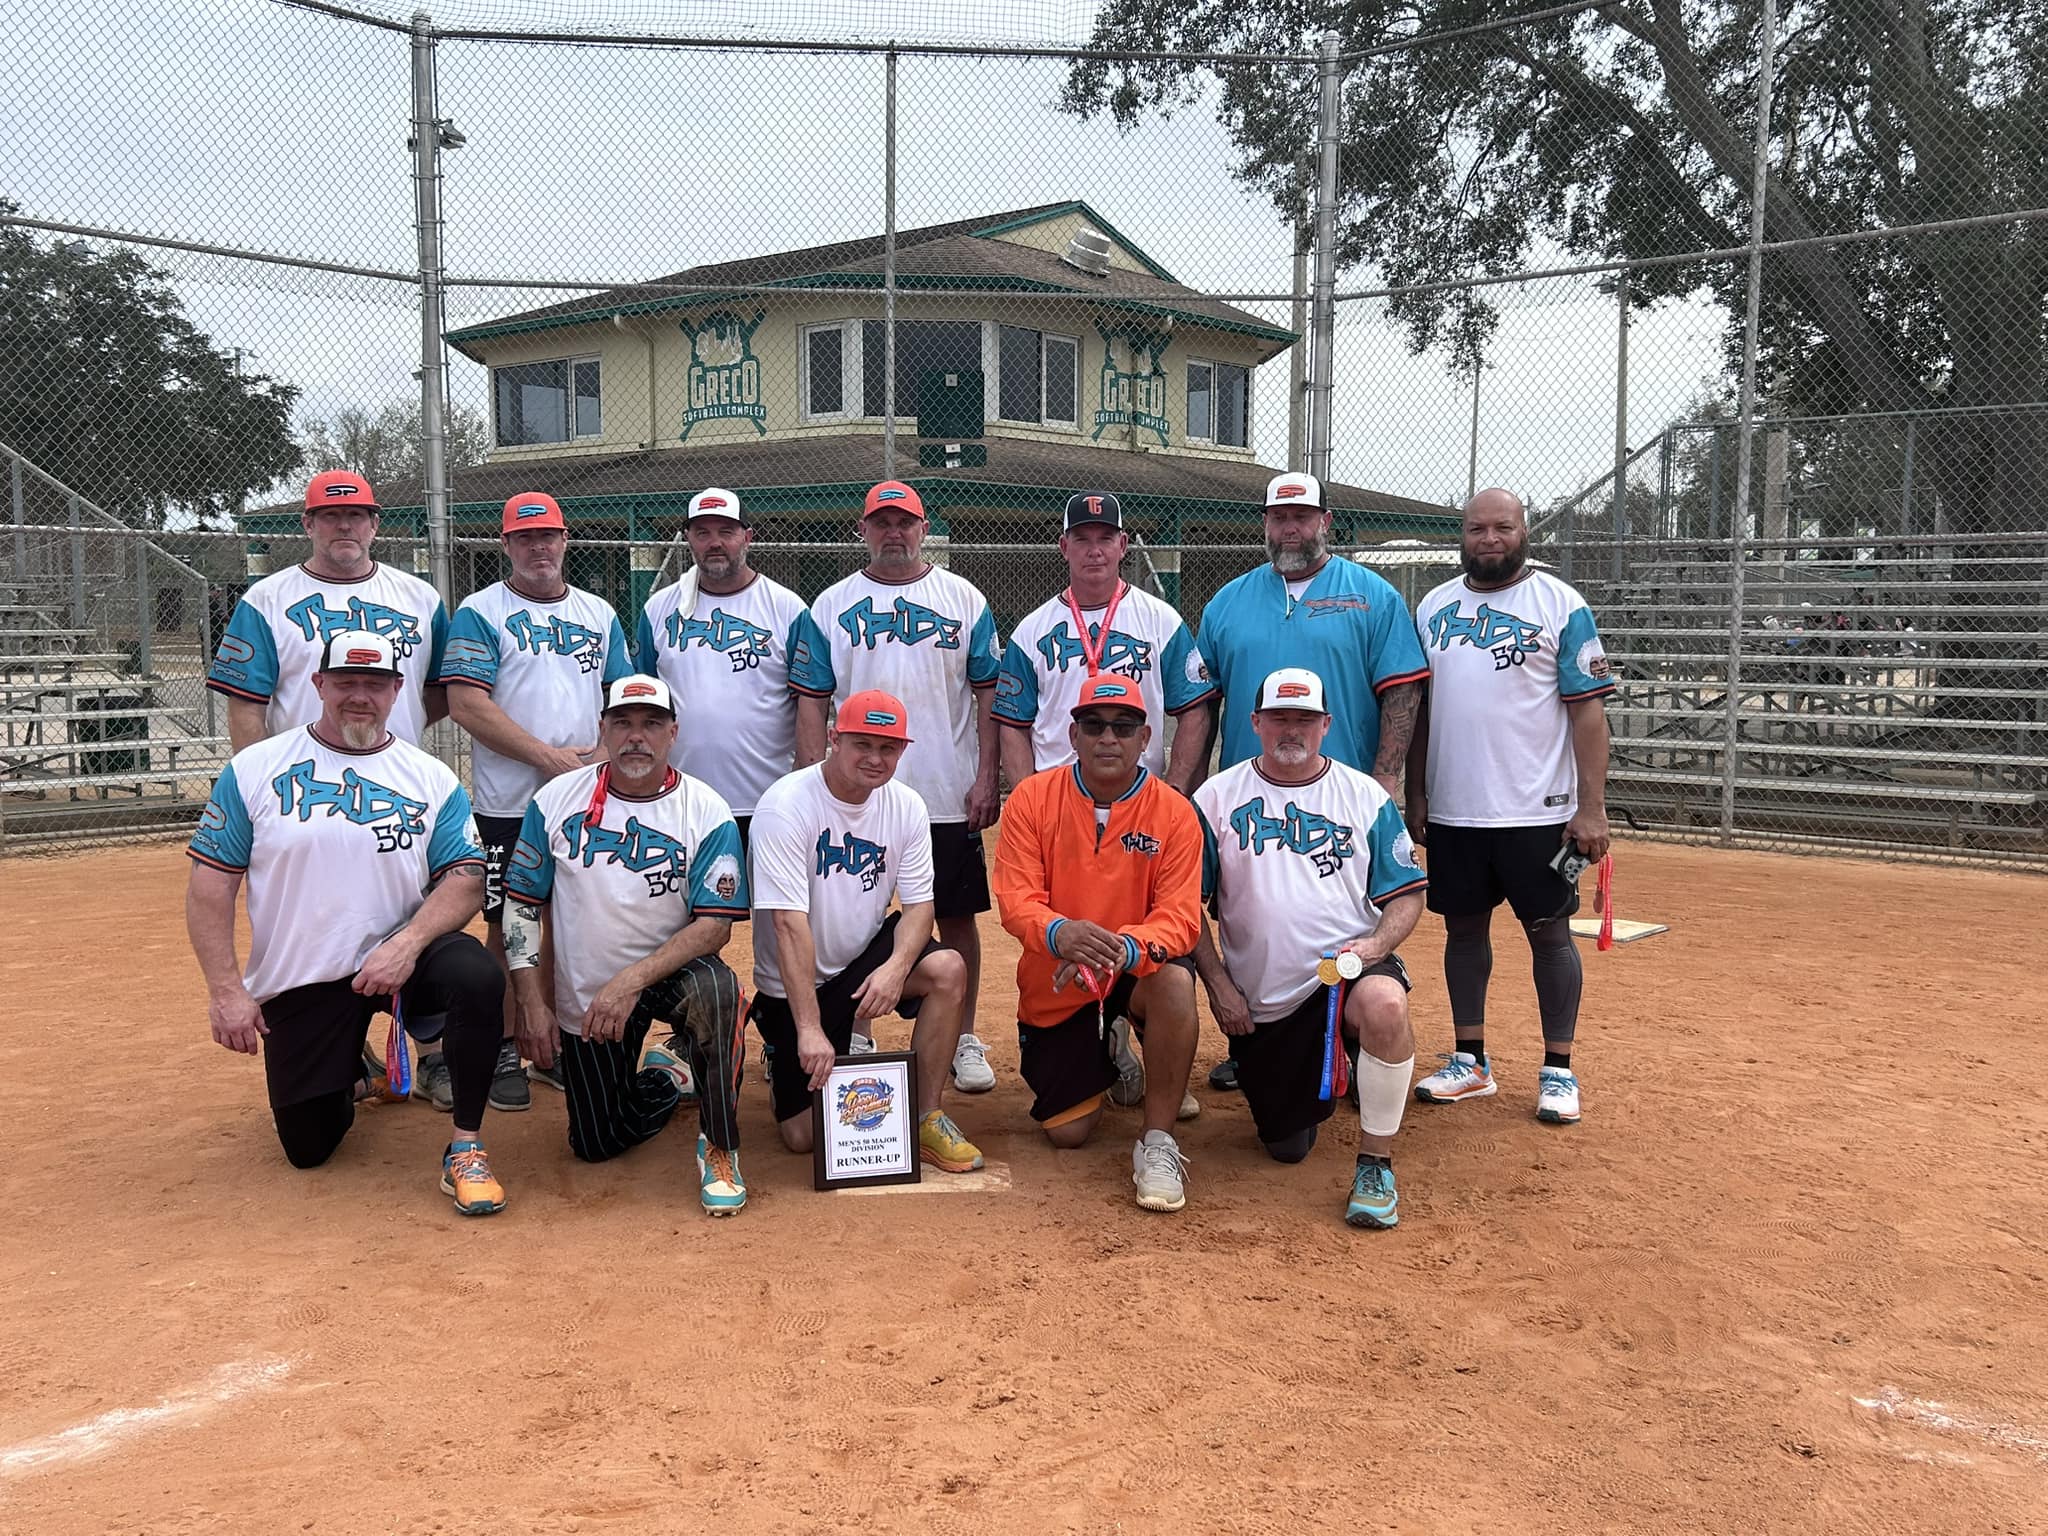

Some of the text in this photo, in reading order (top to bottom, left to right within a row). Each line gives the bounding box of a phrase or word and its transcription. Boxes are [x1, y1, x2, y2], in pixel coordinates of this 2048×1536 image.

[691, 360, 757, 408] GRECO
[682, 405, 764, 423] SOFTBALL COMPLEX
[1095, 412, 1130, 424] SOFTBAL
[325, 484, 359, 497] SP
[876, 488, 907, 502] SP
[1275, 484, 1307, 499] SP
[697, 496, 728, 510] SP
[516, 504, 547, 519] SP
[344, 648, 382, 665] SP
[728, 648, 760, 673] 50
[1491, 645, 1526, 671] 50
[621, 682, 657, 699] SP
[1092, 684, 1127, 699] SP
[1276, 682, 1311, 699] SP
[863, 711, 897, 726] SP
[372, 823, 413, 853] 50
[838, 1139, 861, 1147] MEN'S
[871, 1137, 898, 1145] MAJOR
[851, 1144, 885, 1153] DIVISION
[837, 1154, 901, 1167] RUNNER-UP
